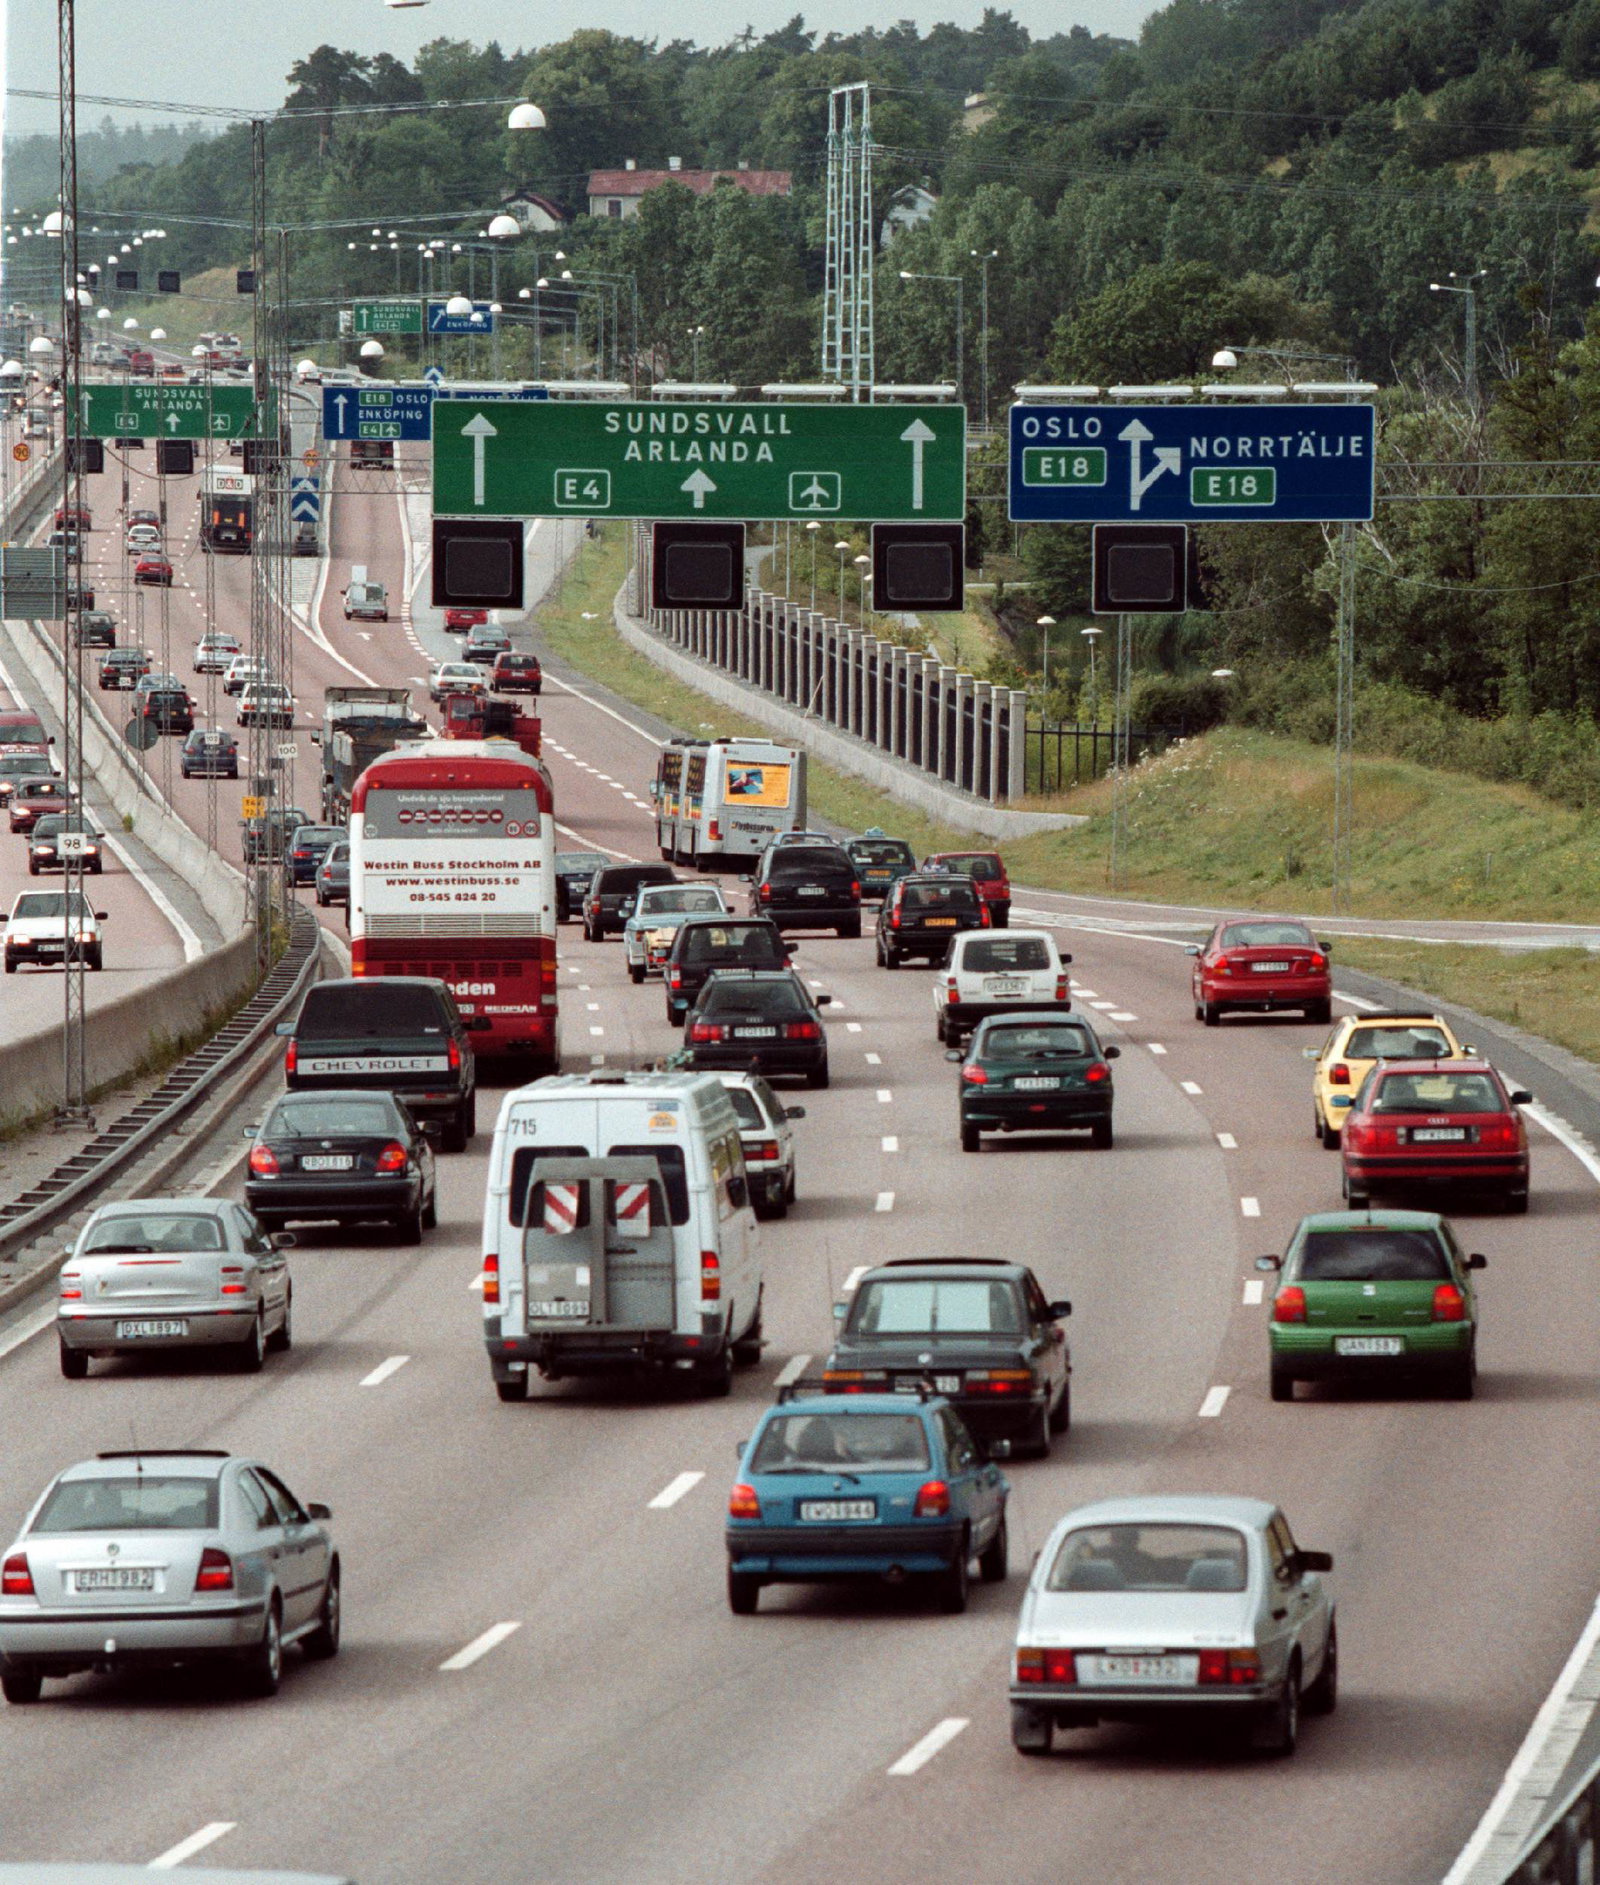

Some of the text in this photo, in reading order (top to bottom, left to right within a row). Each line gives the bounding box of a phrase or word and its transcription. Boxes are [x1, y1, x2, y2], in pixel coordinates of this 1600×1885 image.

[365, 393, 428, 404] E18 OSLO
[359, 408, 423, 420] ENKÖPING
[363, 425, 377, 434] E4
[605, 412, 792, 435] SUNDSVALL
[1022, 417, 1102, 438] OSLO
[1190, 431, 1363, 457] NORRTÄLJE
[15, 447, 29, 458] 90
[624, 440, 774, 463] ARLANDA
[1041, 457, 1089, 478] E18
[565, 479, 600, 500] E4
[1208, 475, 1258, 497] E18
[279, 746, 296, 755] 100
[64, 838, 80, 849] 98
[364, 860, 542, 870] Westin Buss Stockholm AB
[386, 876, 520, 886] www.westinbuss.se
[409, 893, 496, 902] 08-545 424 20
[311, 1058, 434, 1072] CHEVROLET
[511, 1118, 537, 1135] 715
